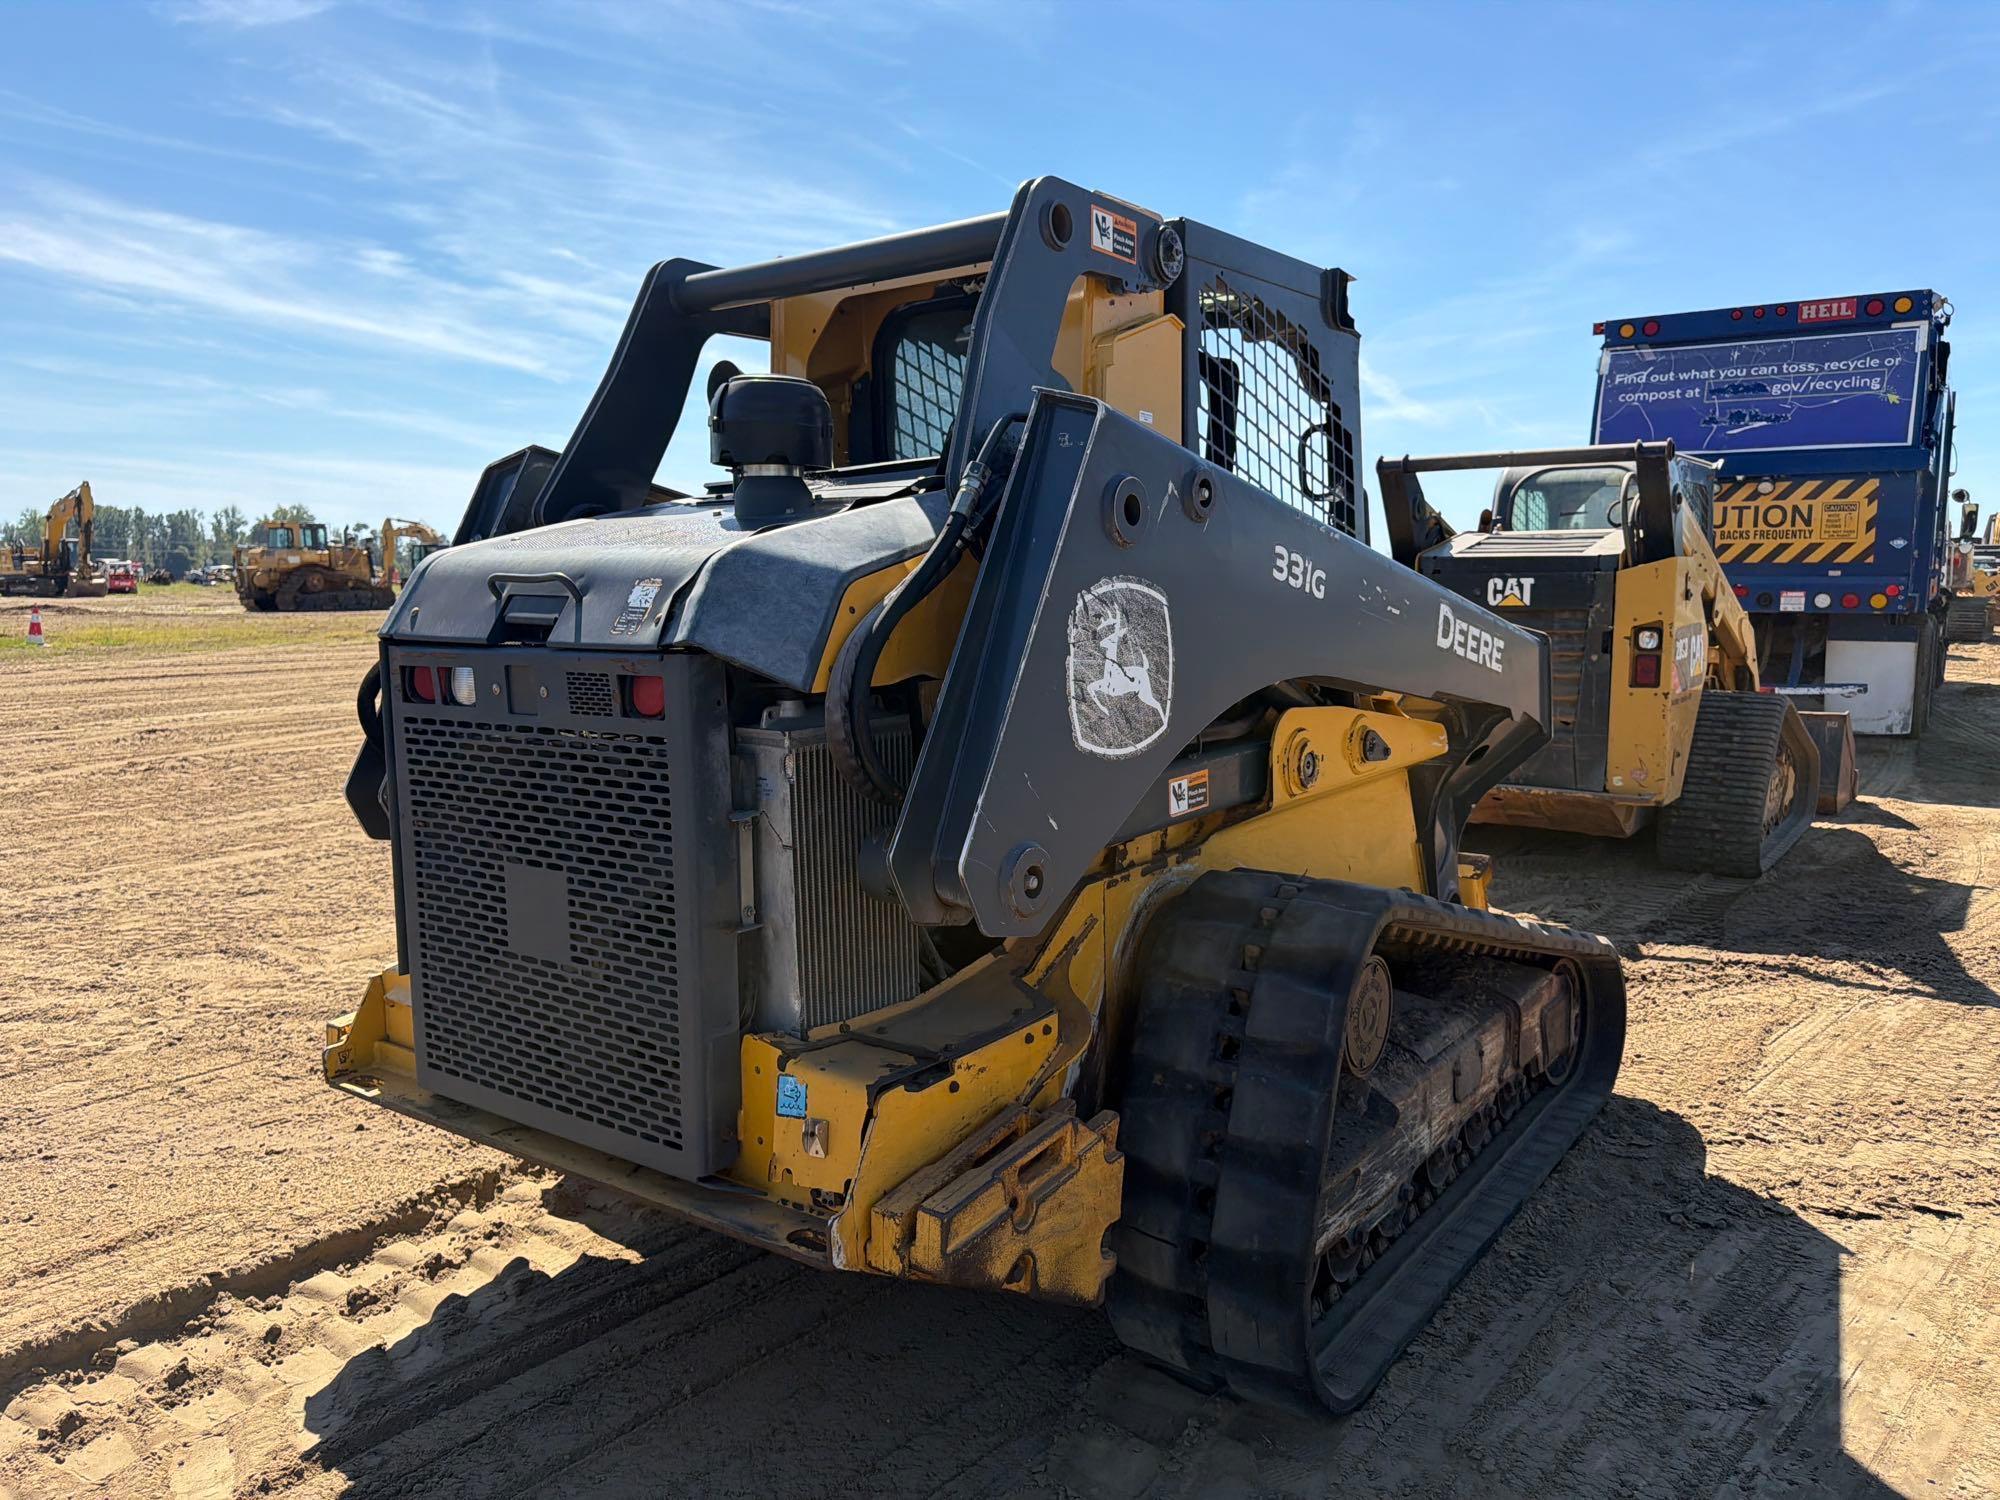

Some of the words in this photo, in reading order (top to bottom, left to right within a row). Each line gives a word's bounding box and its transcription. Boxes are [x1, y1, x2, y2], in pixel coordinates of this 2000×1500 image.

[1802, 302, 1852, 319] HEIL
[1615, 373, 1647, 385] Find
[1650, 371, 1675, 382] out
[1679, 369, 1716, 381] what
[1719, 367, 1747, 380] you
[1750, 365, 1778, 376] can
[1782, 362, 1819, 373] toss,
[1824, 356, 1878, 371] recycle
[1884, 357, 1901, 367] or
[1618, 388, 1682, 403] compost
[1684, 387, 1701, 398] at
[1713, 504, 1814, 529] UTION
[1824, 503, 1857, 512] CAUTION
[1720, 530, 1751, 540] BACKS
[1753, 529, 1814, 540] FREQUENTLY
[1272, 545, 1327, 600] 331G
[1487, 576, 1535, 607] CAT
[1985, 580, 1999, 592] CAT
[1436, 603, 1505, 673] DEERE
